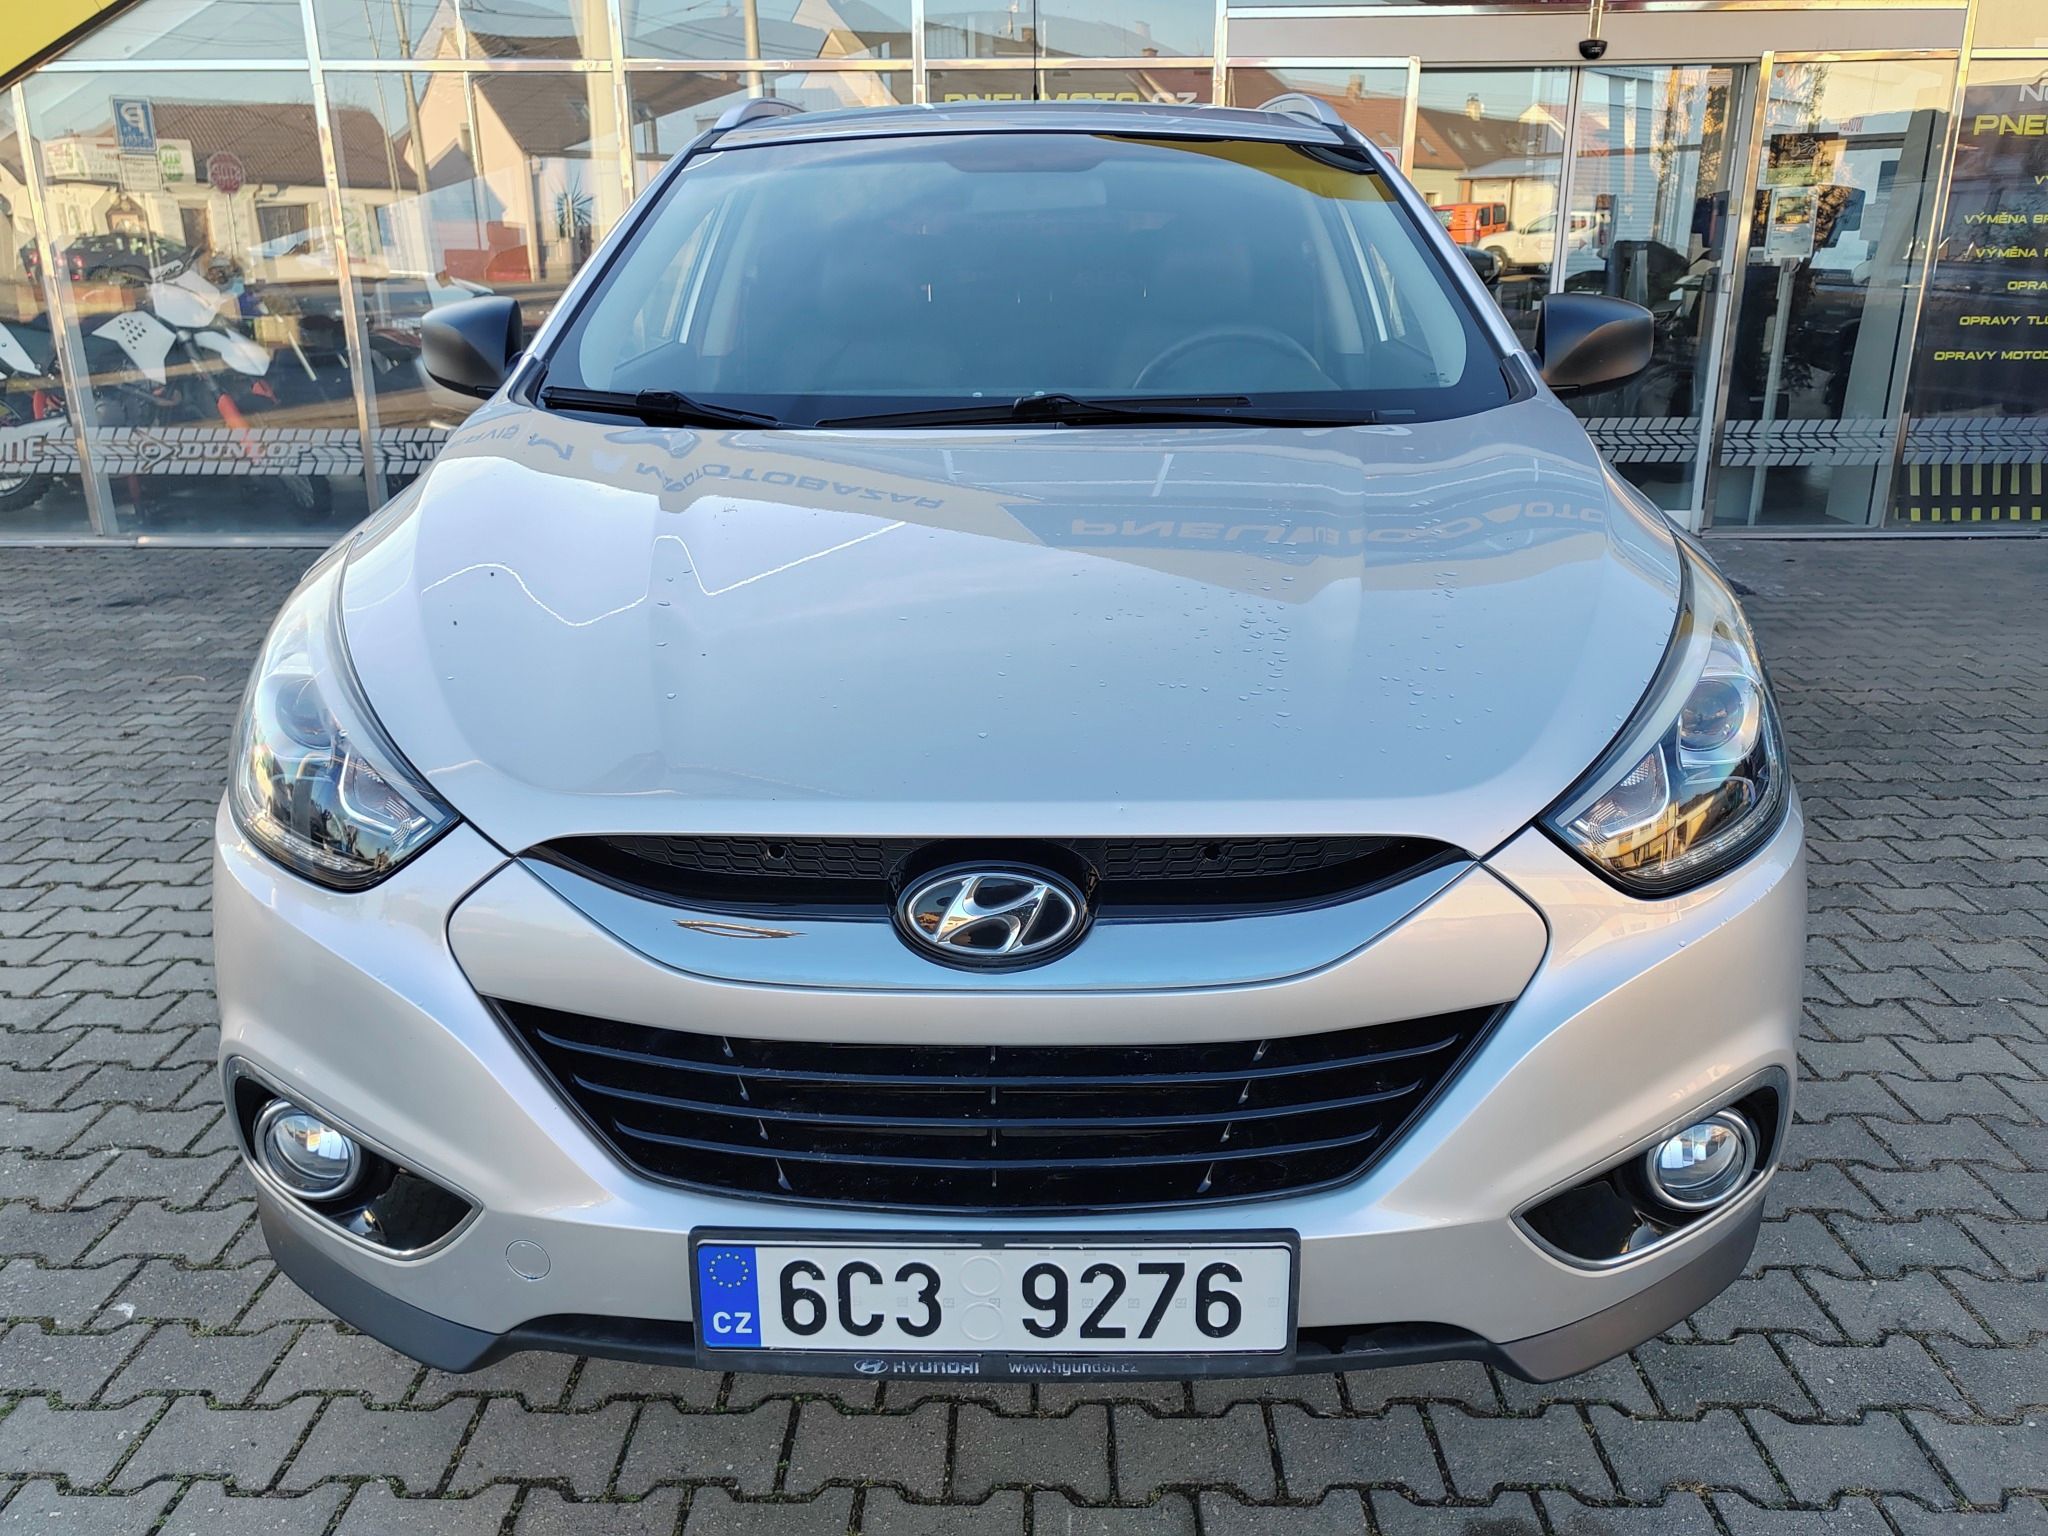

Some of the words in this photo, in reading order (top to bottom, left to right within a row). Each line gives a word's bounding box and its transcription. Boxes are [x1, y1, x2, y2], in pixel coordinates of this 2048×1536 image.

[1973, 114, 2048, 136] PNE
[1964, 211, 2028, 224] VÝMĚNA
[1976, 246, 2038, 258] VÝMĚNA
[1959, 315, 2021, 326] OPRAVY
[1934, 351, 1997, 361] OPRAVY
[178, 441, 313, 460] DUNLOP
[778, 1260, 943, 1337] 6C3
[1020, 1261, 1244, 1339] 9276
[711, 1310, 753, 1335] CZ
[893, 1361, 980, 1375] HYUNDAI
